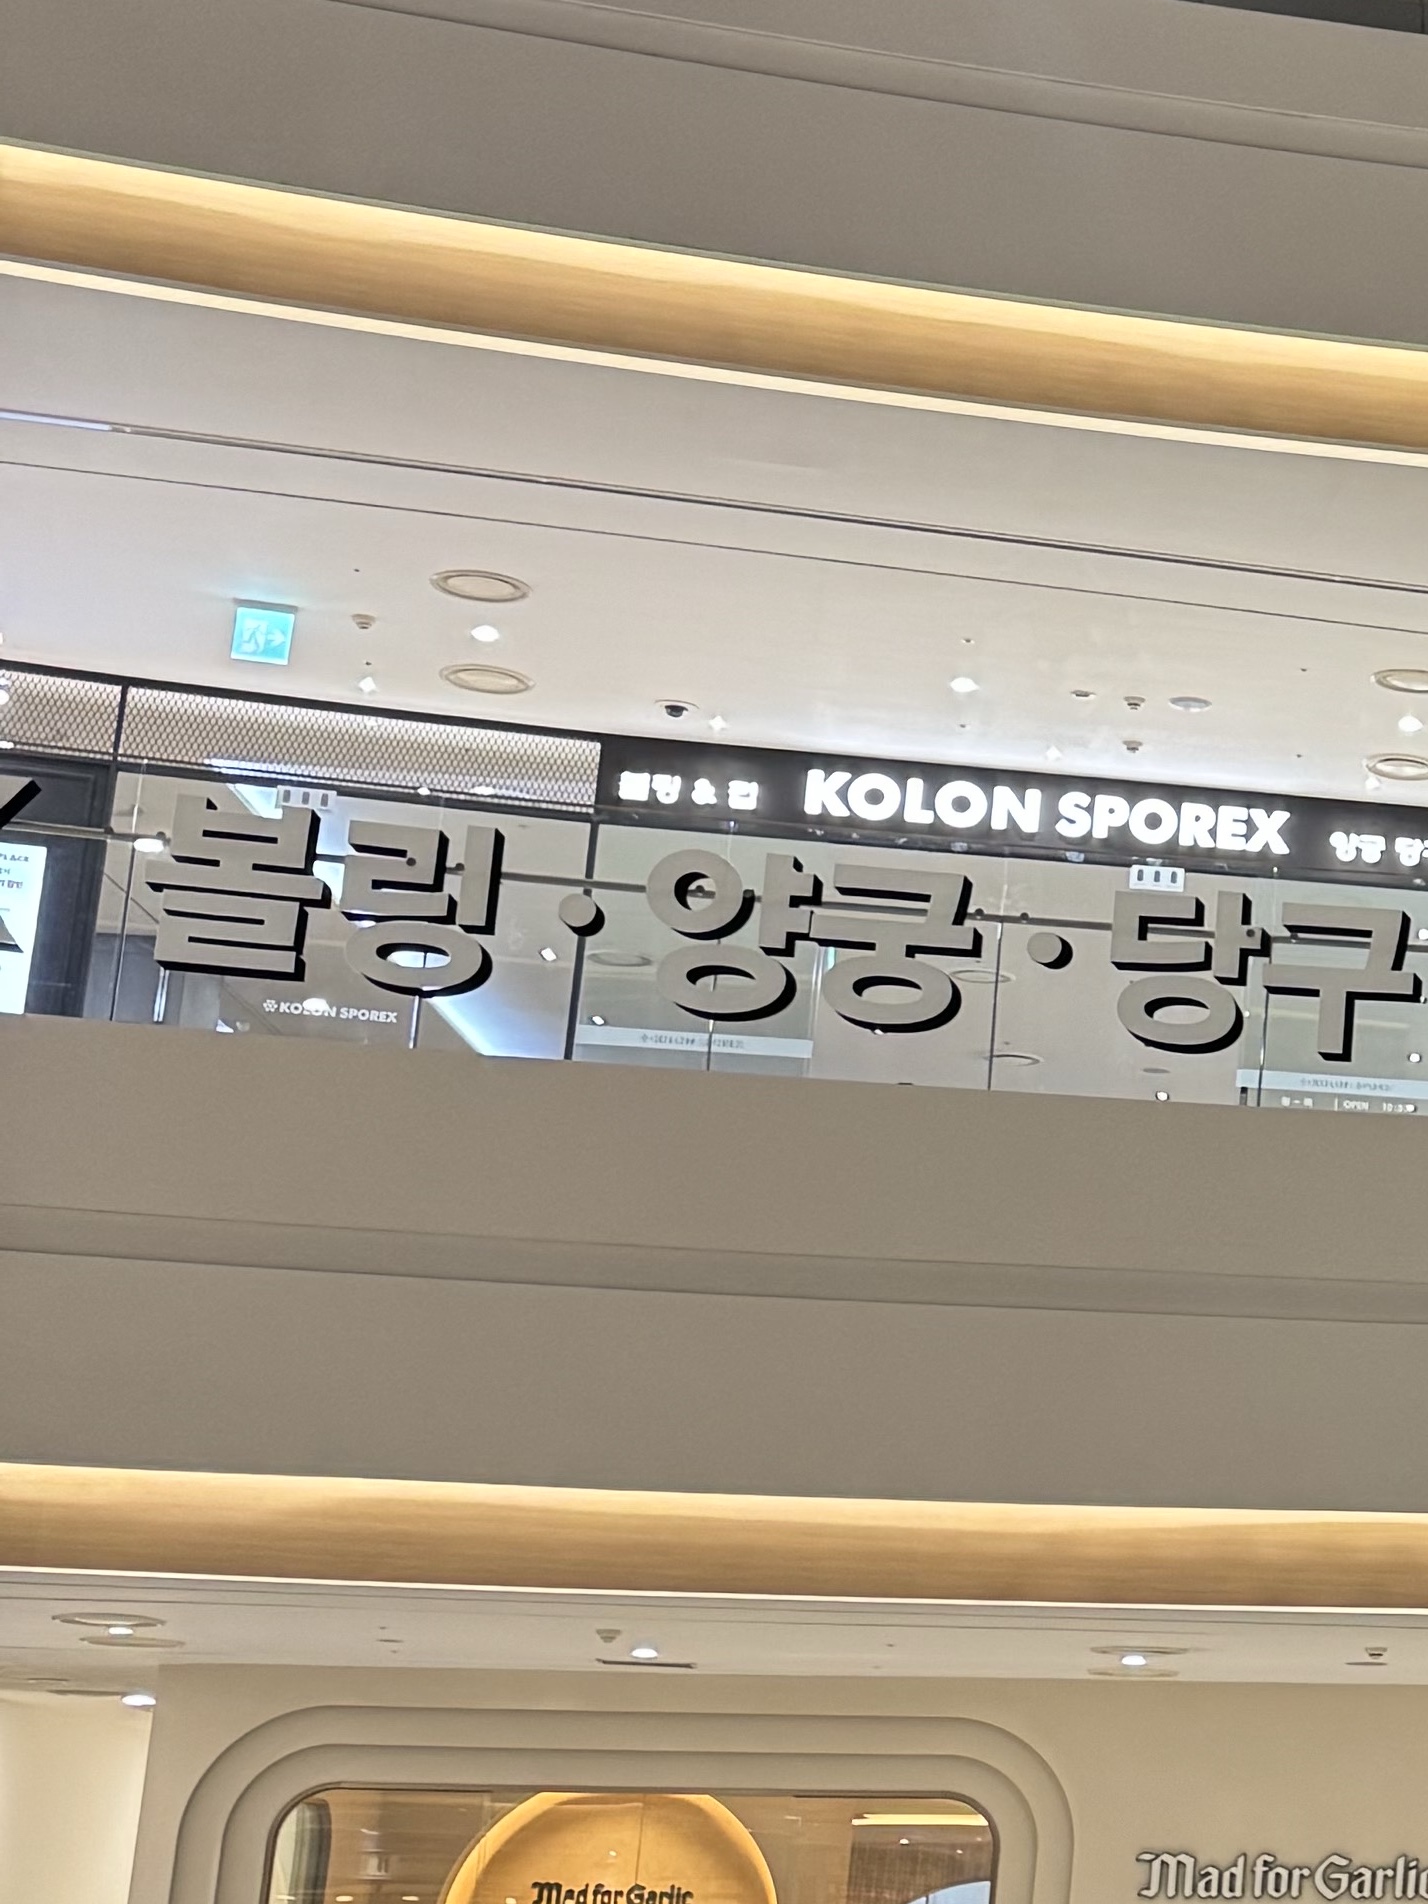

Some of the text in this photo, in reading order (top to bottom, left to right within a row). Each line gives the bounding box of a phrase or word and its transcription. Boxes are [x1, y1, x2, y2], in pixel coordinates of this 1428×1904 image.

[803, 768, 1042, 834] KOLON
[1055, 792, 1291, 856] SPOREX
[339, 1005, 397, 1023] SPOREX
[1136, 1851, 1245, 1900] Mad
[1252, 1853, 1310, 1900] for
